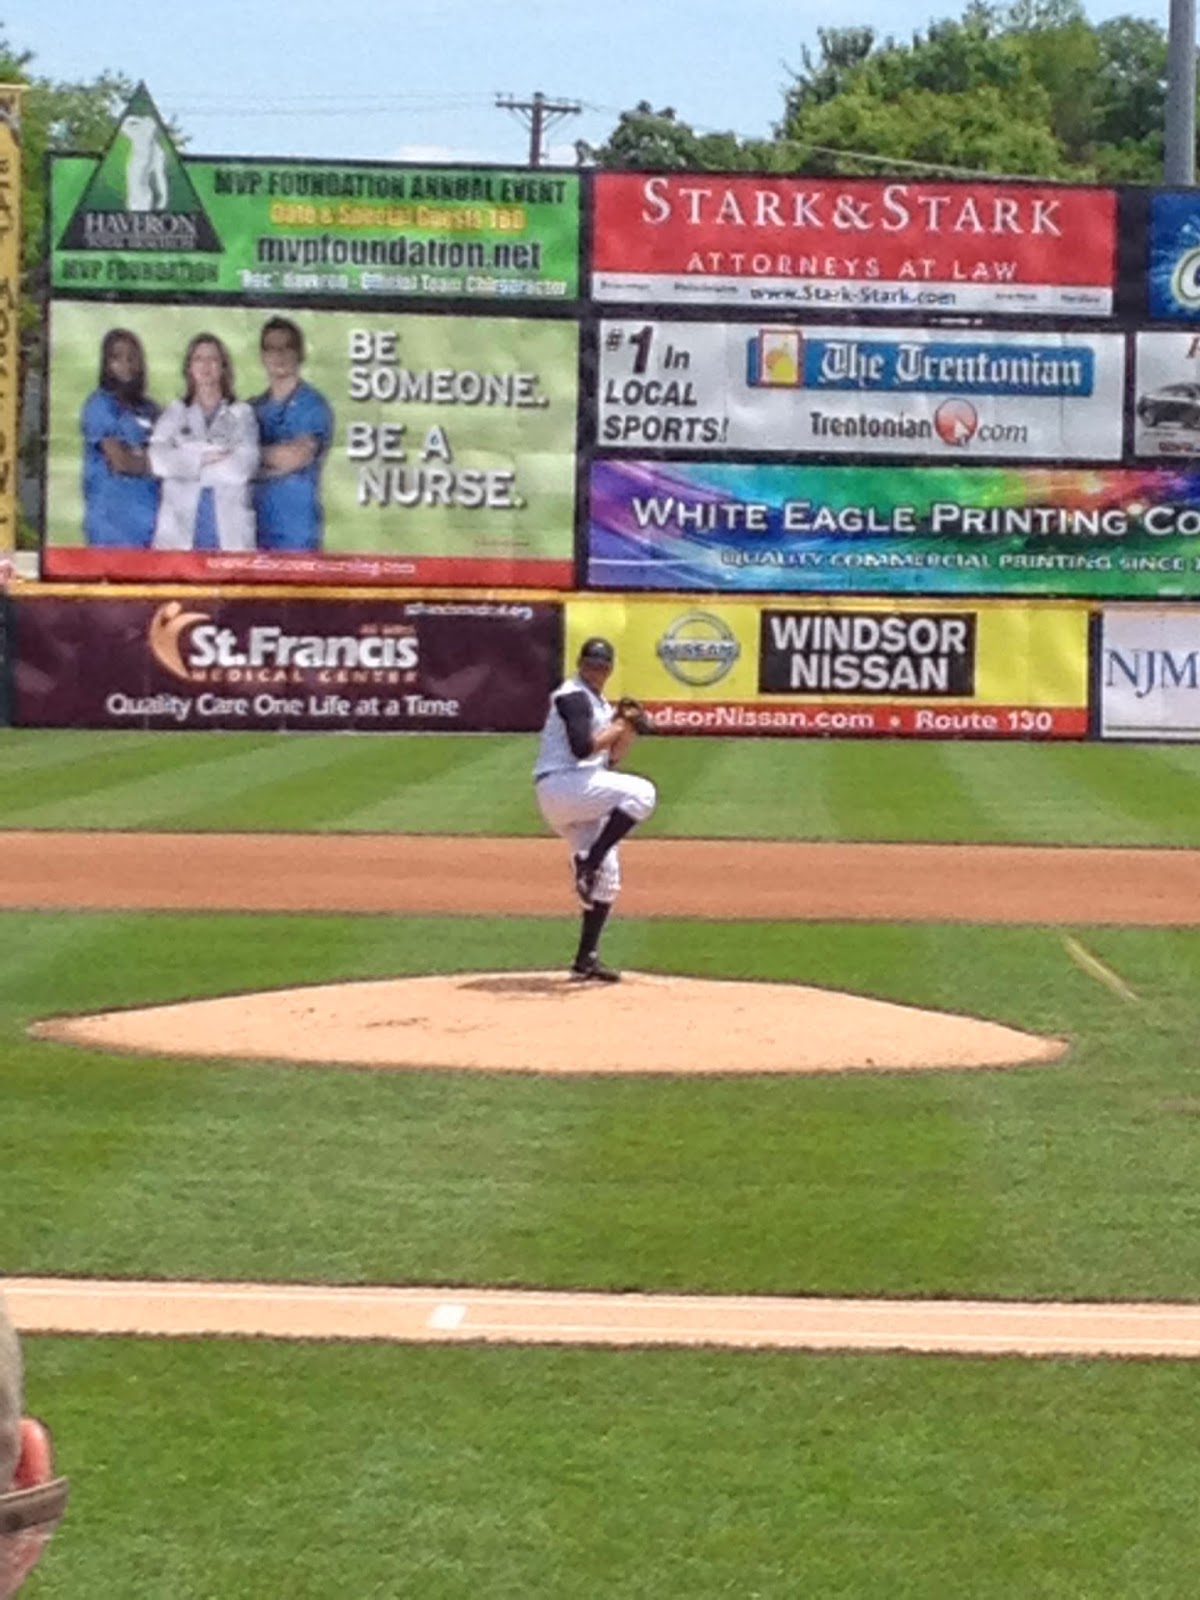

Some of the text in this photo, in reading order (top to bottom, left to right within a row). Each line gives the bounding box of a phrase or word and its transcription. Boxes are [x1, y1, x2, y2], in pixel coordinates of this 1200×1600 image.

[214, 170, 567, 204] MVP FOUNDATION ANNUAL EVENT
[257, 233, 541, 271] mvpfoundation.net
[686, 252, 1018, 282] ATTORNEYS AT LAW
[751, 285, 956, 305] www.Stark-Stark.com
[347, 329, 399, 366] BE
[664, 346, 691, 370] In
[820, 342, 1082, 388] The Trentonian
[348, 367, 549, 409] SOMEONE.
[603, 379, 698, 407] LOCAL
[602, 415, 729, 444] SPORTS!
[810, 411, 932, 439] Trentonian
[346, 422, 452, 464] BE A
[356, 467, 526, 509] NURSE.
[632, 497, 768, 532] WHITE
[782, 501, 917, 534] EAGLE
[931, 503, 1128, 536] PRINTING
[720, 549, 824, 567] QUALITY
[830, 551, 991, 570] COMMERCIAL
[999, 553, 1112, 570] PRINTING
[1120, 556, 1185, 572] SINCE
[770, 615, 967, 656] WINDSOR
[191, 669, 418, 683] MEDICAL CENTER
[789, 654, 949, 691] NISSAN
[1104, 649, 1199, 698] NJM
[107, 693, 460, 721] Quality Care One Life at a Time
[643, 706, 1054, 734] ndsorNissan.com Route 130
